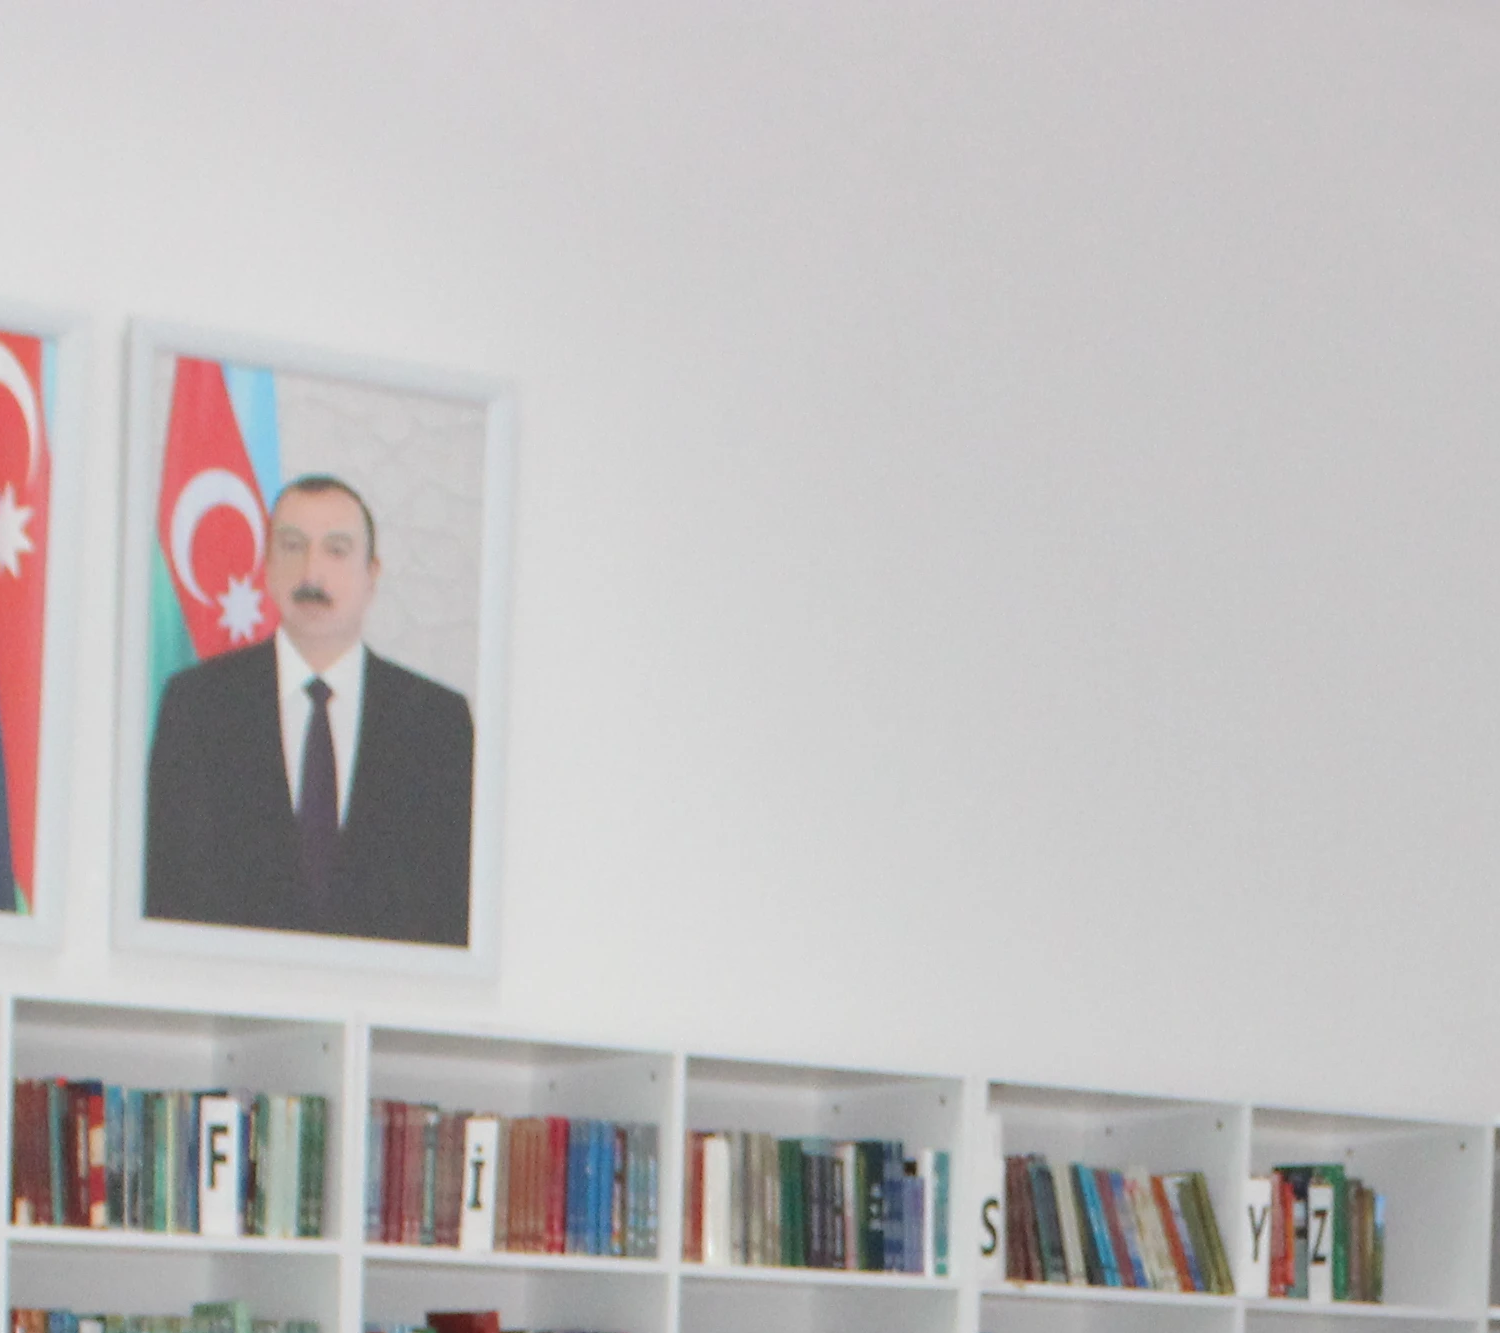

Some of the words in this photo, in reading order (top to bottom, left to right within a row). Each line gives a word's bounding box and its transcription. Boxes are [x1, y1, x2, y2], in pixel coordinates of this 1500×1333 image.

[206, 1125, 229, 1190] F
[981, 1199, 997, 1256] S
[1249, 1205, 1269, 1263] Y
[1311, 1210, 1329, 1267] Z
